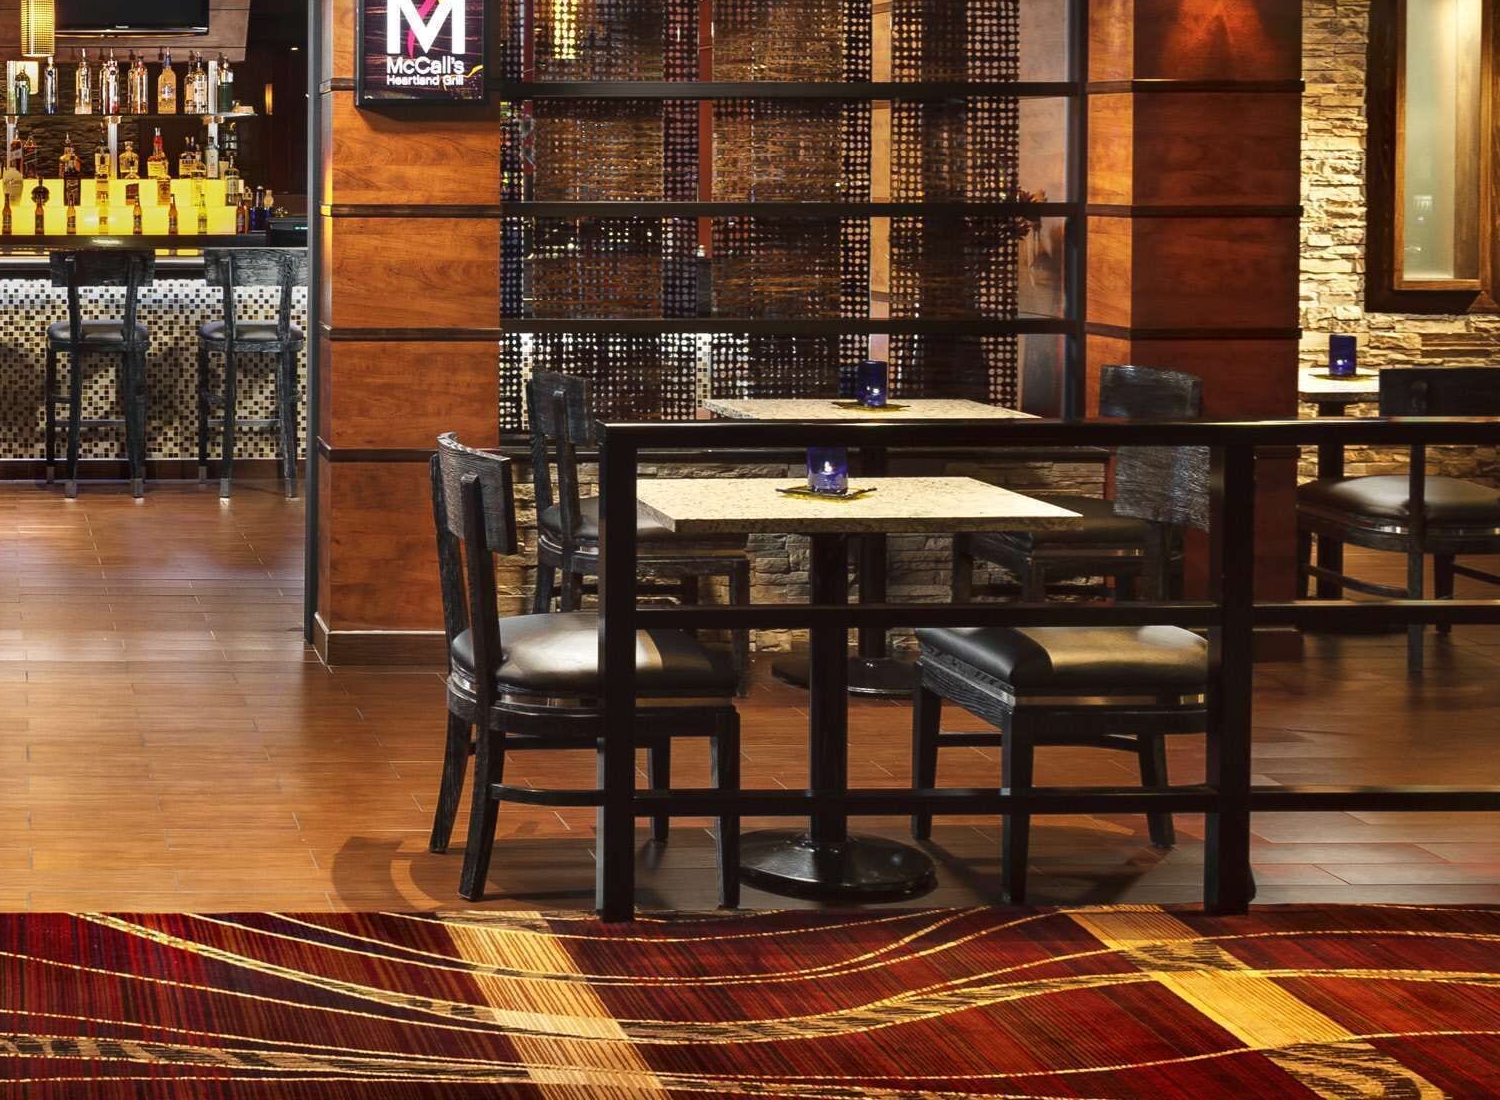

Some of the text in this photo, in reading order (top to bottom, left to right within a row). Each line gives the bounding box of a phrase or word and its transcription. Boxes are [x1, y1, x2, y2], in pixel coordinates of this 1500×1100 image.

[386, 55, 465, 75] McCall's
[386, 74, 464, 86] Heartland Grill
